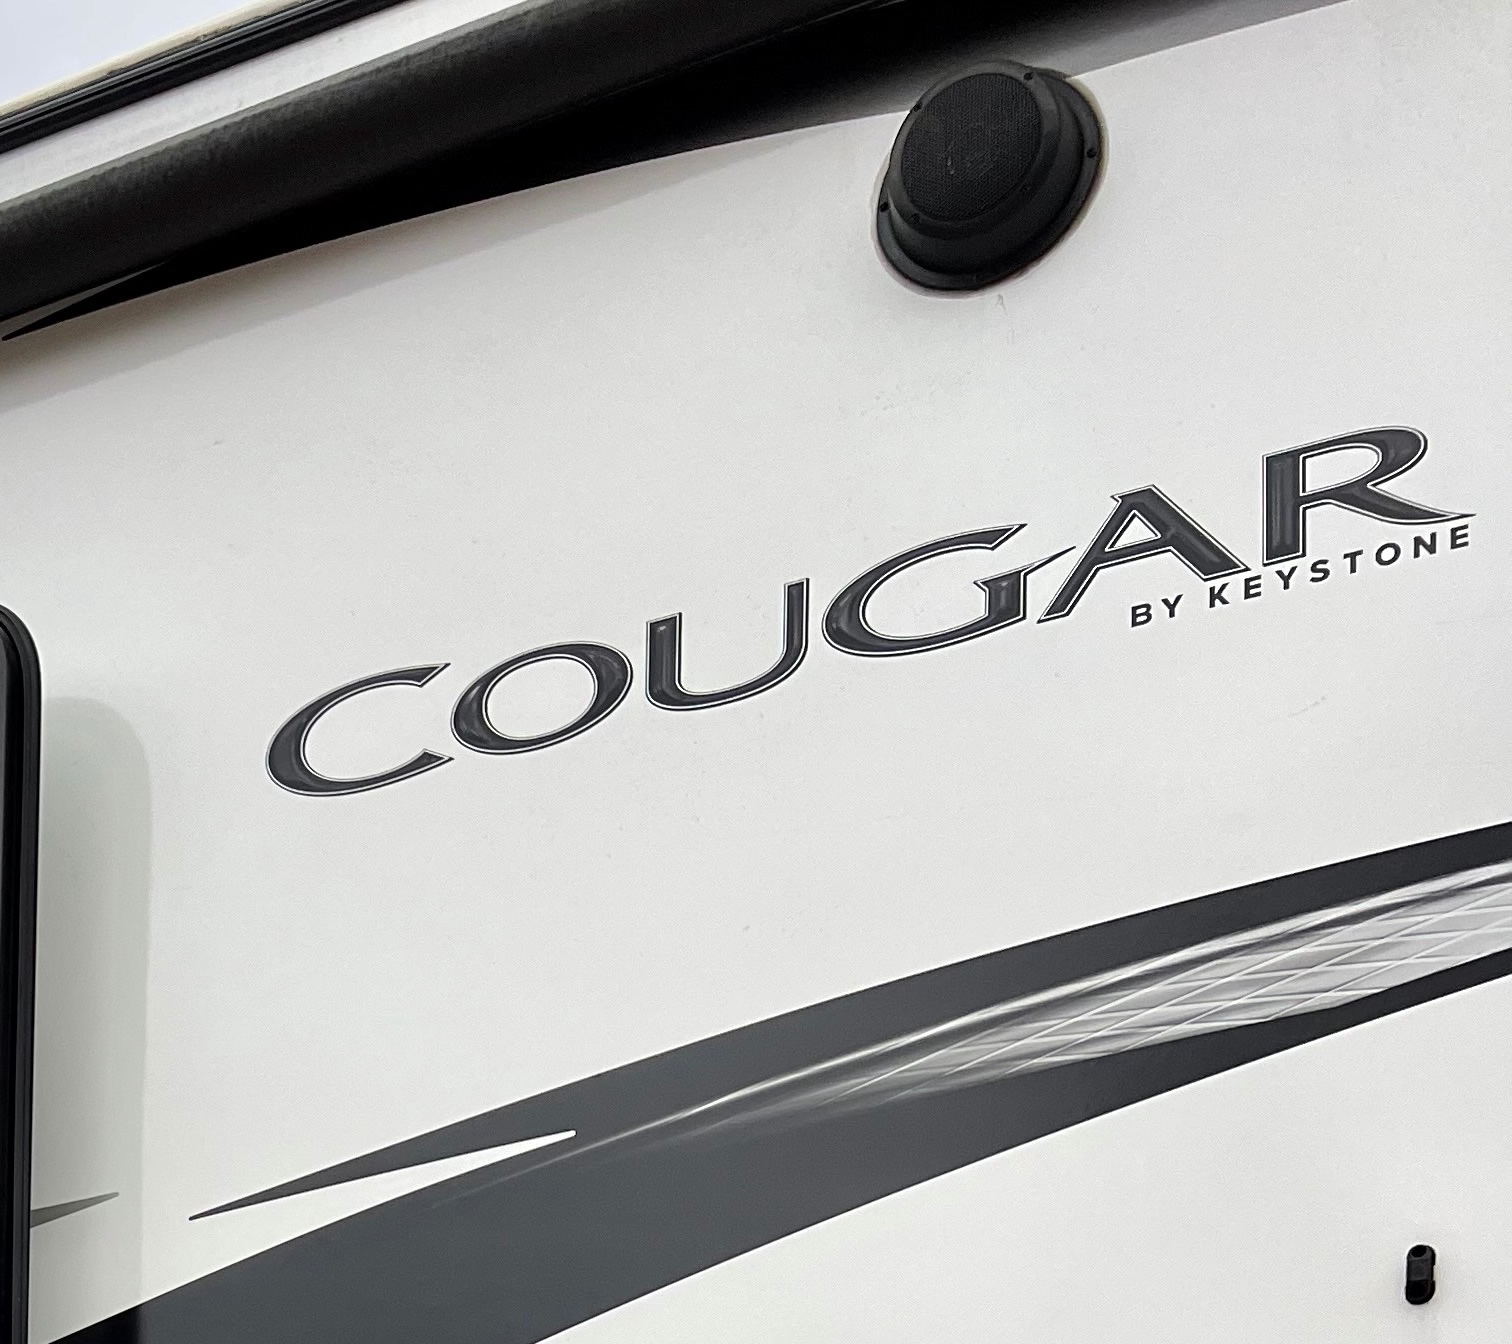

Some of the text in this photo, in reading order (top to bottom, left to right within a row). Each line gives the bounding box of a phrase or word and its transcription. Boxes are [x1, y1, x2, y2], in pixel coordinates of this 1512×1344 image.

[265, 425, 1478, 797] COUGAR
[1131, 523, 1470, 628] BY KEYSTONE
